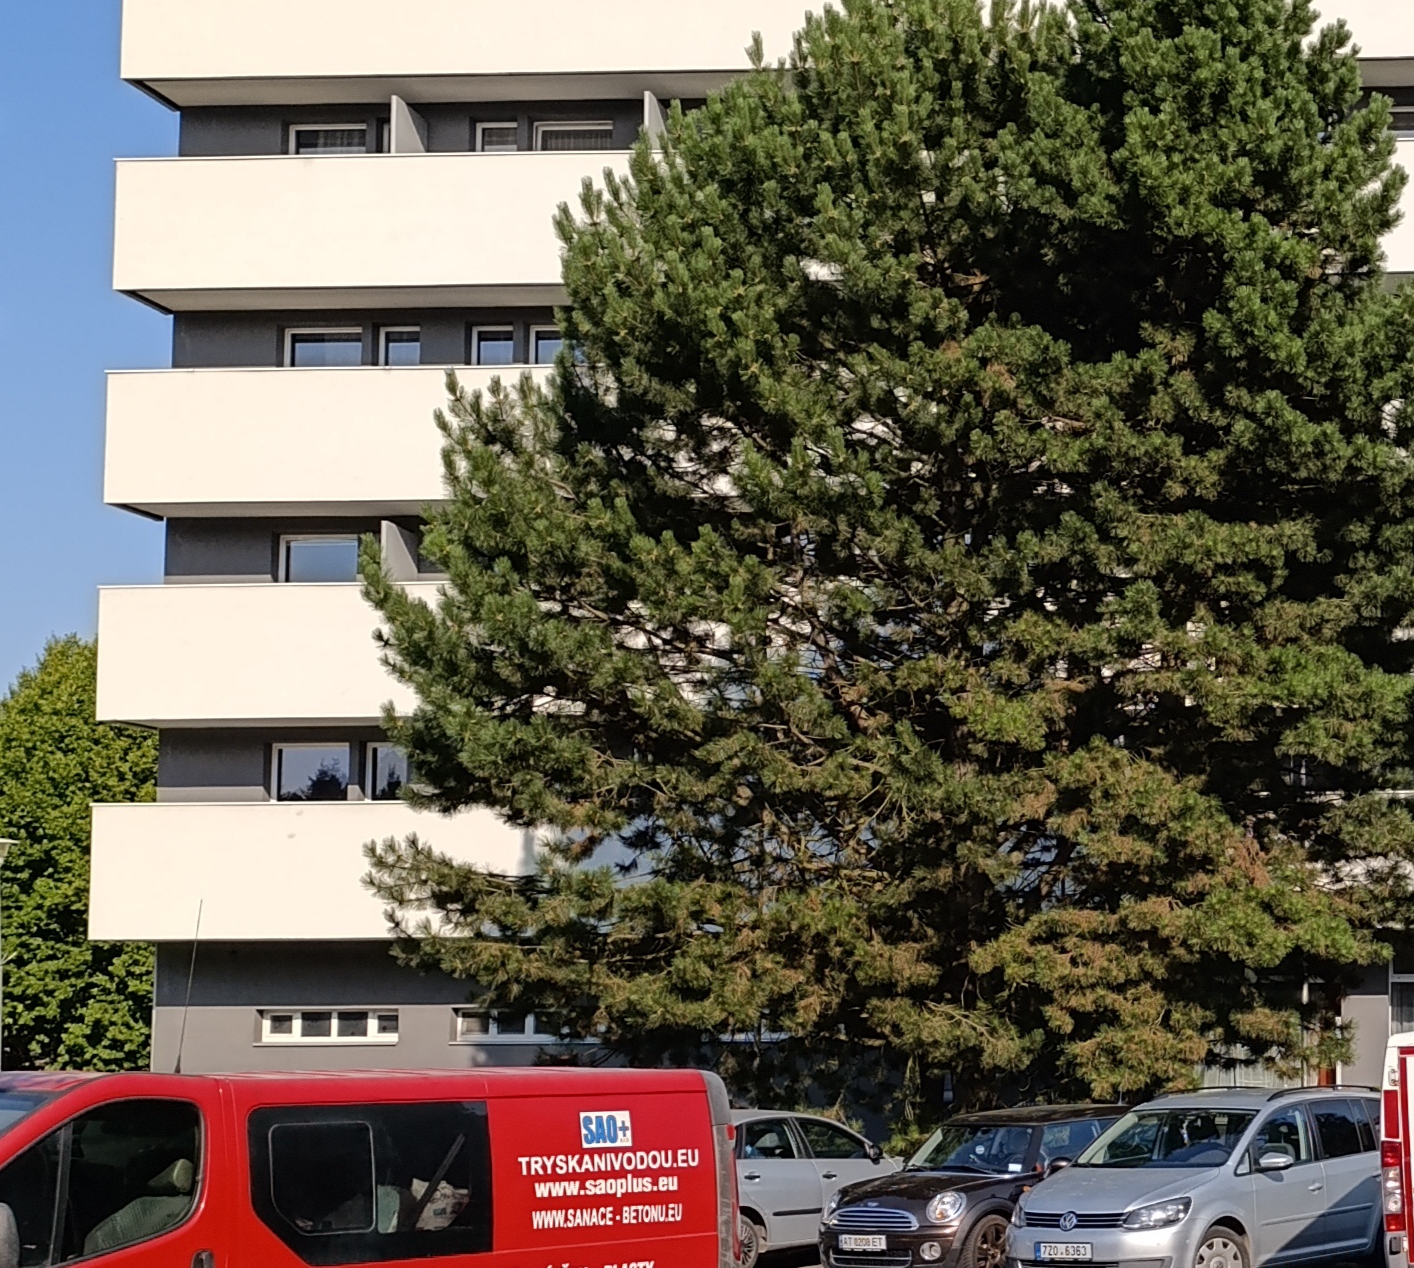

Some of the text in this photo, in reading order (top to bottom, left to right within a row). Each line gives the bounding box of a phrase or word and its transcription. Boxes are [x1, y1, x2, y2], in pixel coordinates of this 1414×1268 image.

[517, 1148, 700, 1176] TRYSKANIVODOU.EU
[534, 1173, 679, 1198] www.saoplus.eu
[532, 1206, 614, 1230] WWW.SANACE
[622, 1203, 683, 1225] BETONU.EU
[1064, 1245, 1087, 1257] 6363
